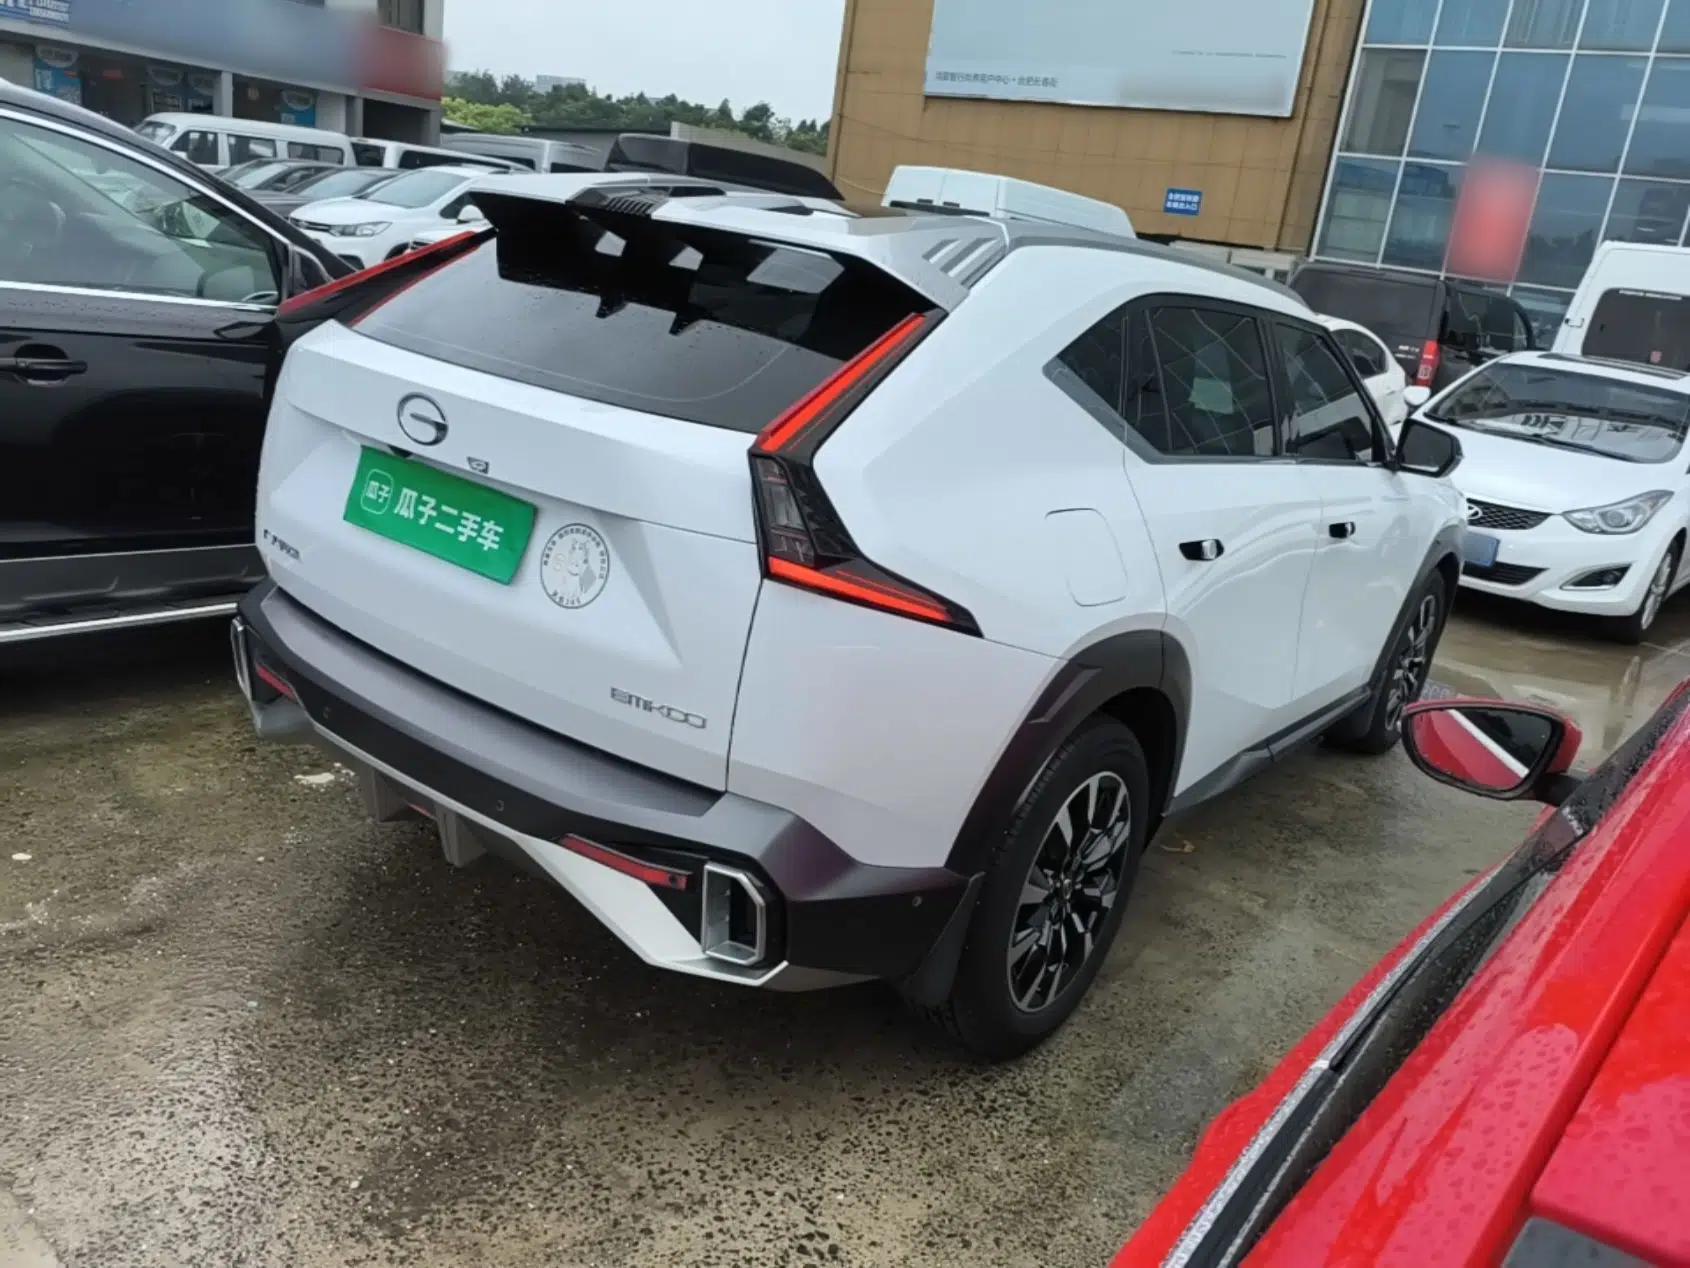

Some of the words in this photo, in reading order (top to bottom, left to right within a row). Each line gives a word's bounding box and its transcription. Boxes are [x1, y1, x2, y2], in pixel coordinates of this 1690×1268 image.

[366, 480, 391, 503] 瓜子
[394, 487, 504, 551] 瓜子二手车
